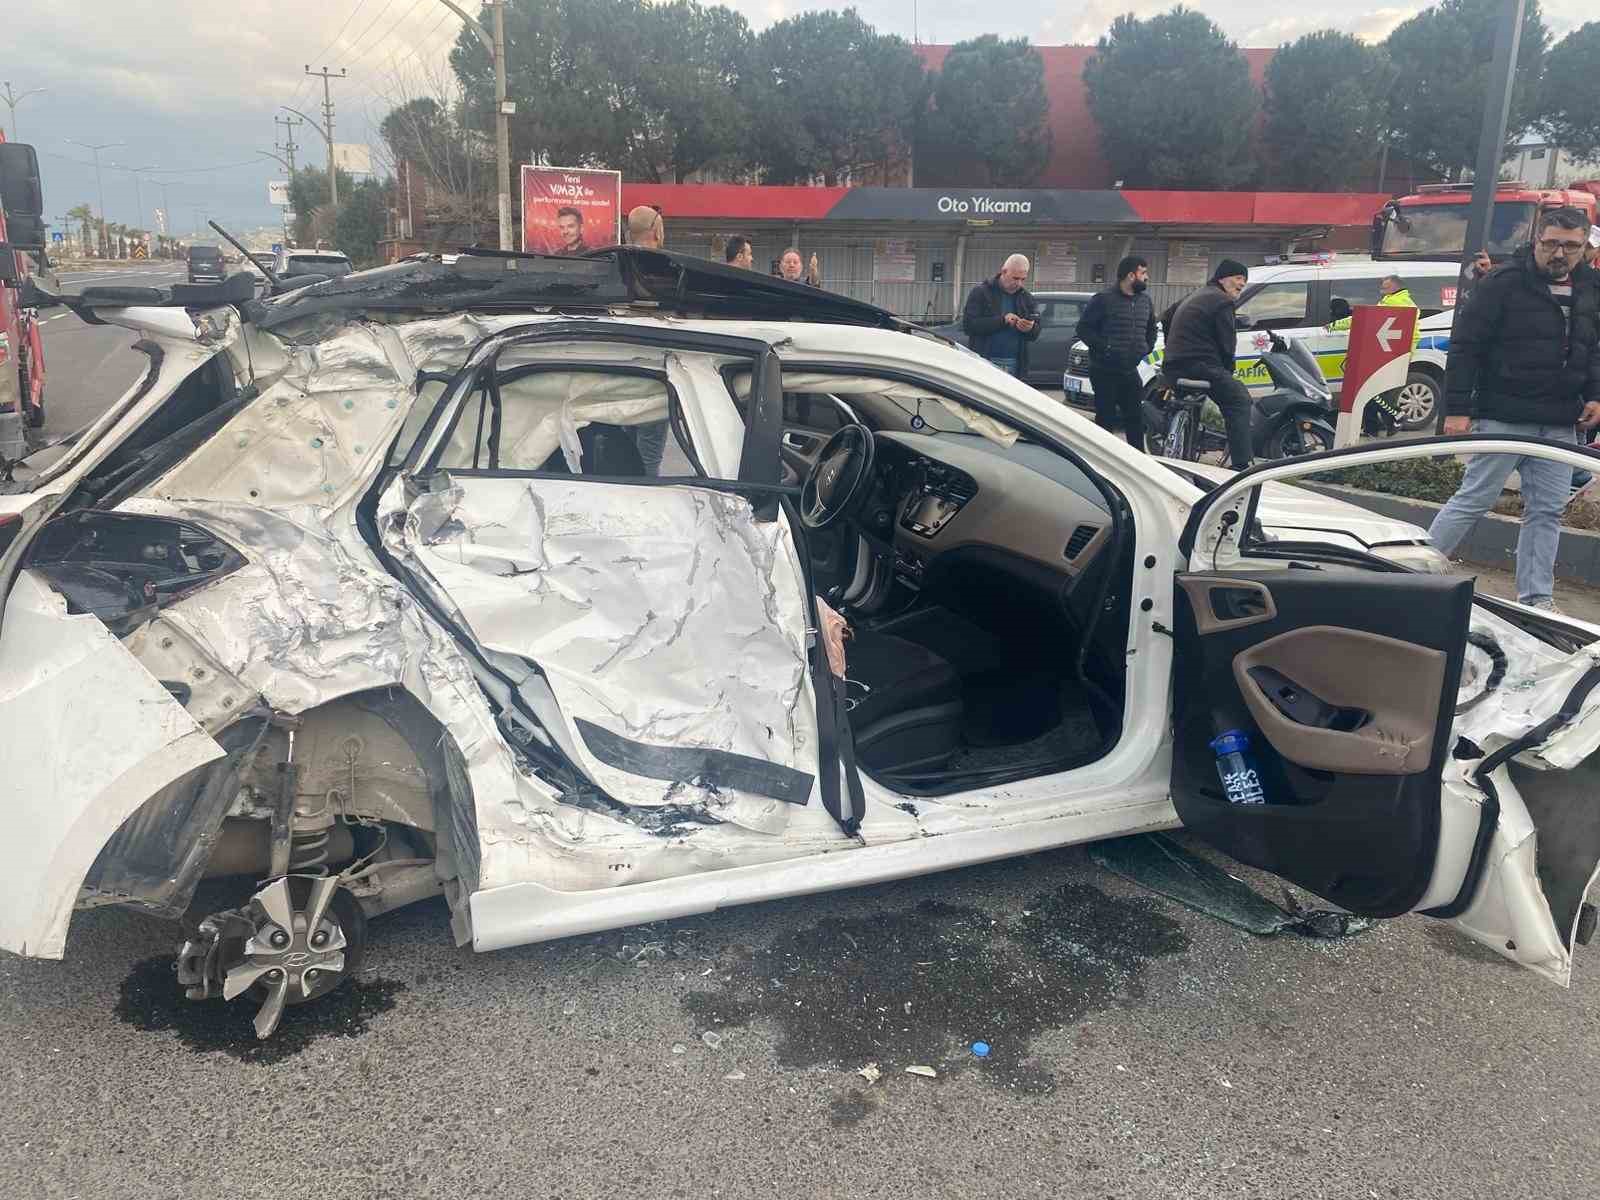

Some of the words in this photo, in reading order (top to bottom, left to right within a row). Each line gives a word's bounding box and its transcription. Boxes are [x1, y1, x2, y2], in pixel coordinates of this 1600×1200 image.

[563, 174, 580, 184] Yeni
[938, 197, 968, 212] Oto
[972, 197, 1031, 213] Yıkama
[1224, 772, 1245, 803] EAK
